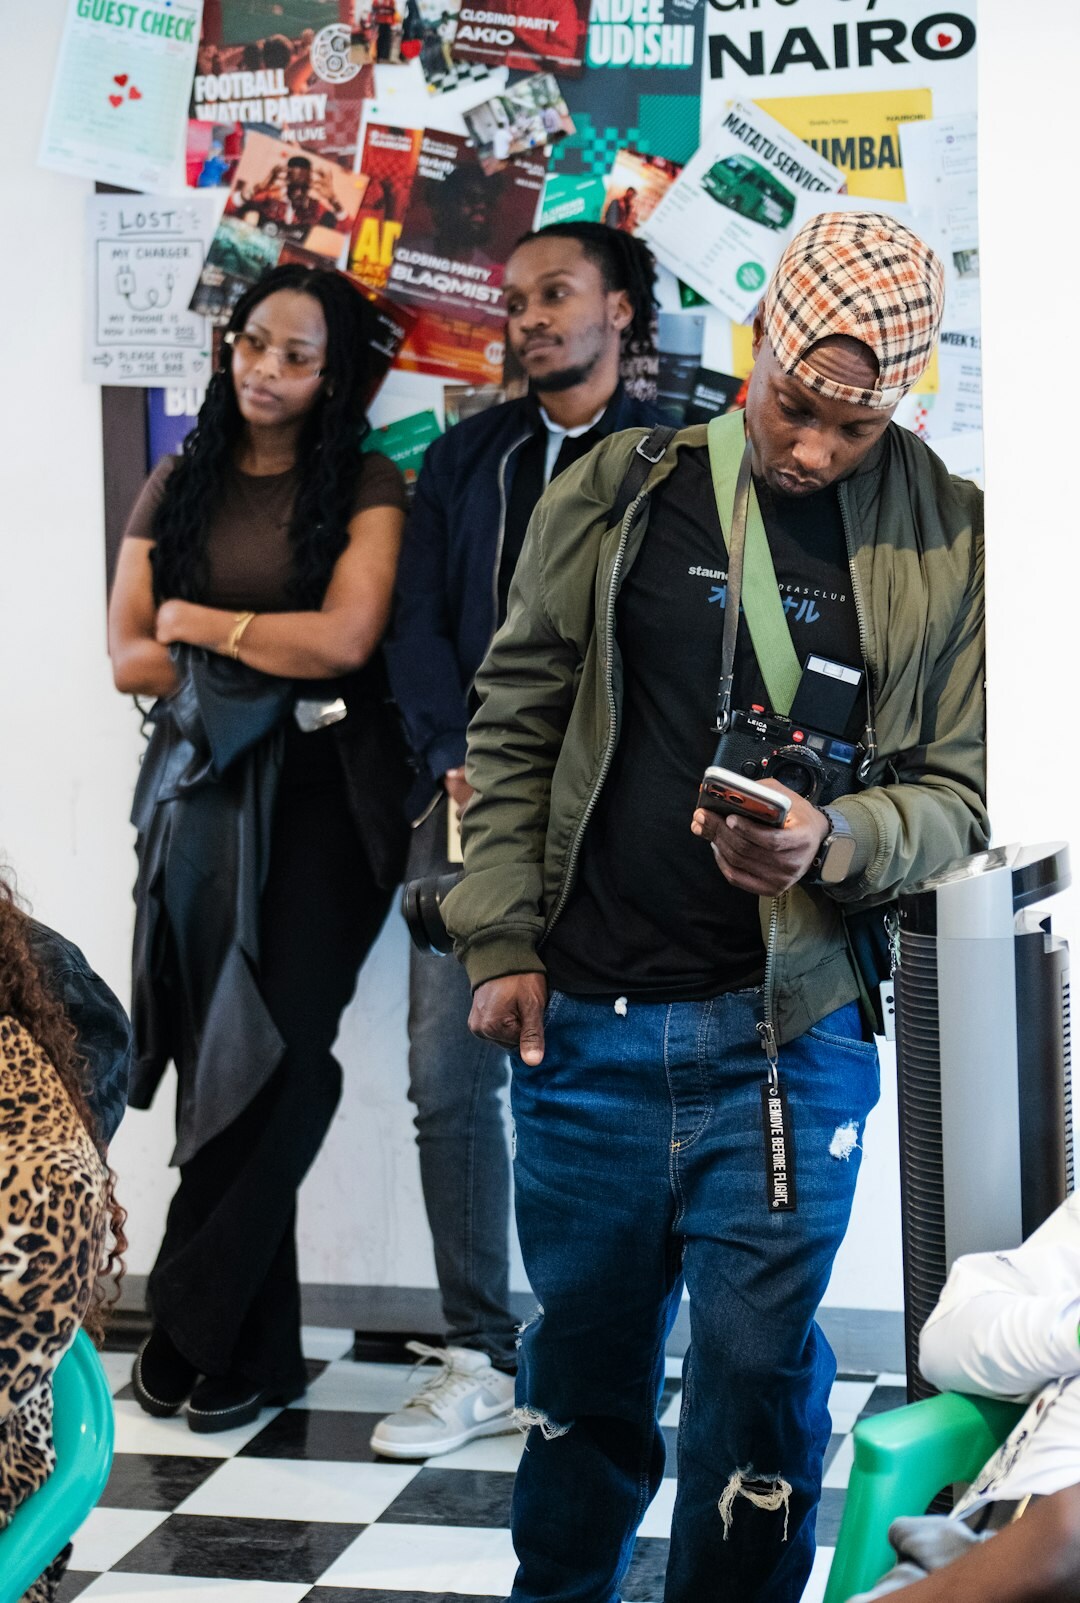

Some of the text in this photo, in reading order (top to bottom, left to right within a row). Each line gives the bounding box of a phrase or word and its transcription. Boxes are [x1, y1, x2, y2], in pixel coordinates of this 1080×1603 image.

[77, 0, 197, 43] GUEST CHECK
[459, 8, 560, 32] CLOSING PARTY
[456, 25, 515, 46] AKIO
[589, 24, 695, 66] UDISHI
[194, 68, 289, 102] FOOTBALL
[196, 94, 328, 124] WATCH PARTY
[297, 127, 327, 142] LIVE
[721, 112, 778, 161] MATATU
[119, 209, 176, 229] LOST
[113, 247, 189, 259] MY CHARGER
[395, 248, 492, 282] CLOSING PARTY
[391, 265, 503, 304] BLAQMIST
[109, 314, 125, 323] MY
[940, 331, 967, 346] WEEK
[118, 351, 184, 361] PLEASE GIVE
[139, 363, 158, 373] THE
[688, 566, 728, 580] staun
[747, 718, 768, 729] LEICA
[768, 1098, 788, 1205] REMOVE BEFORE FLIGHT
